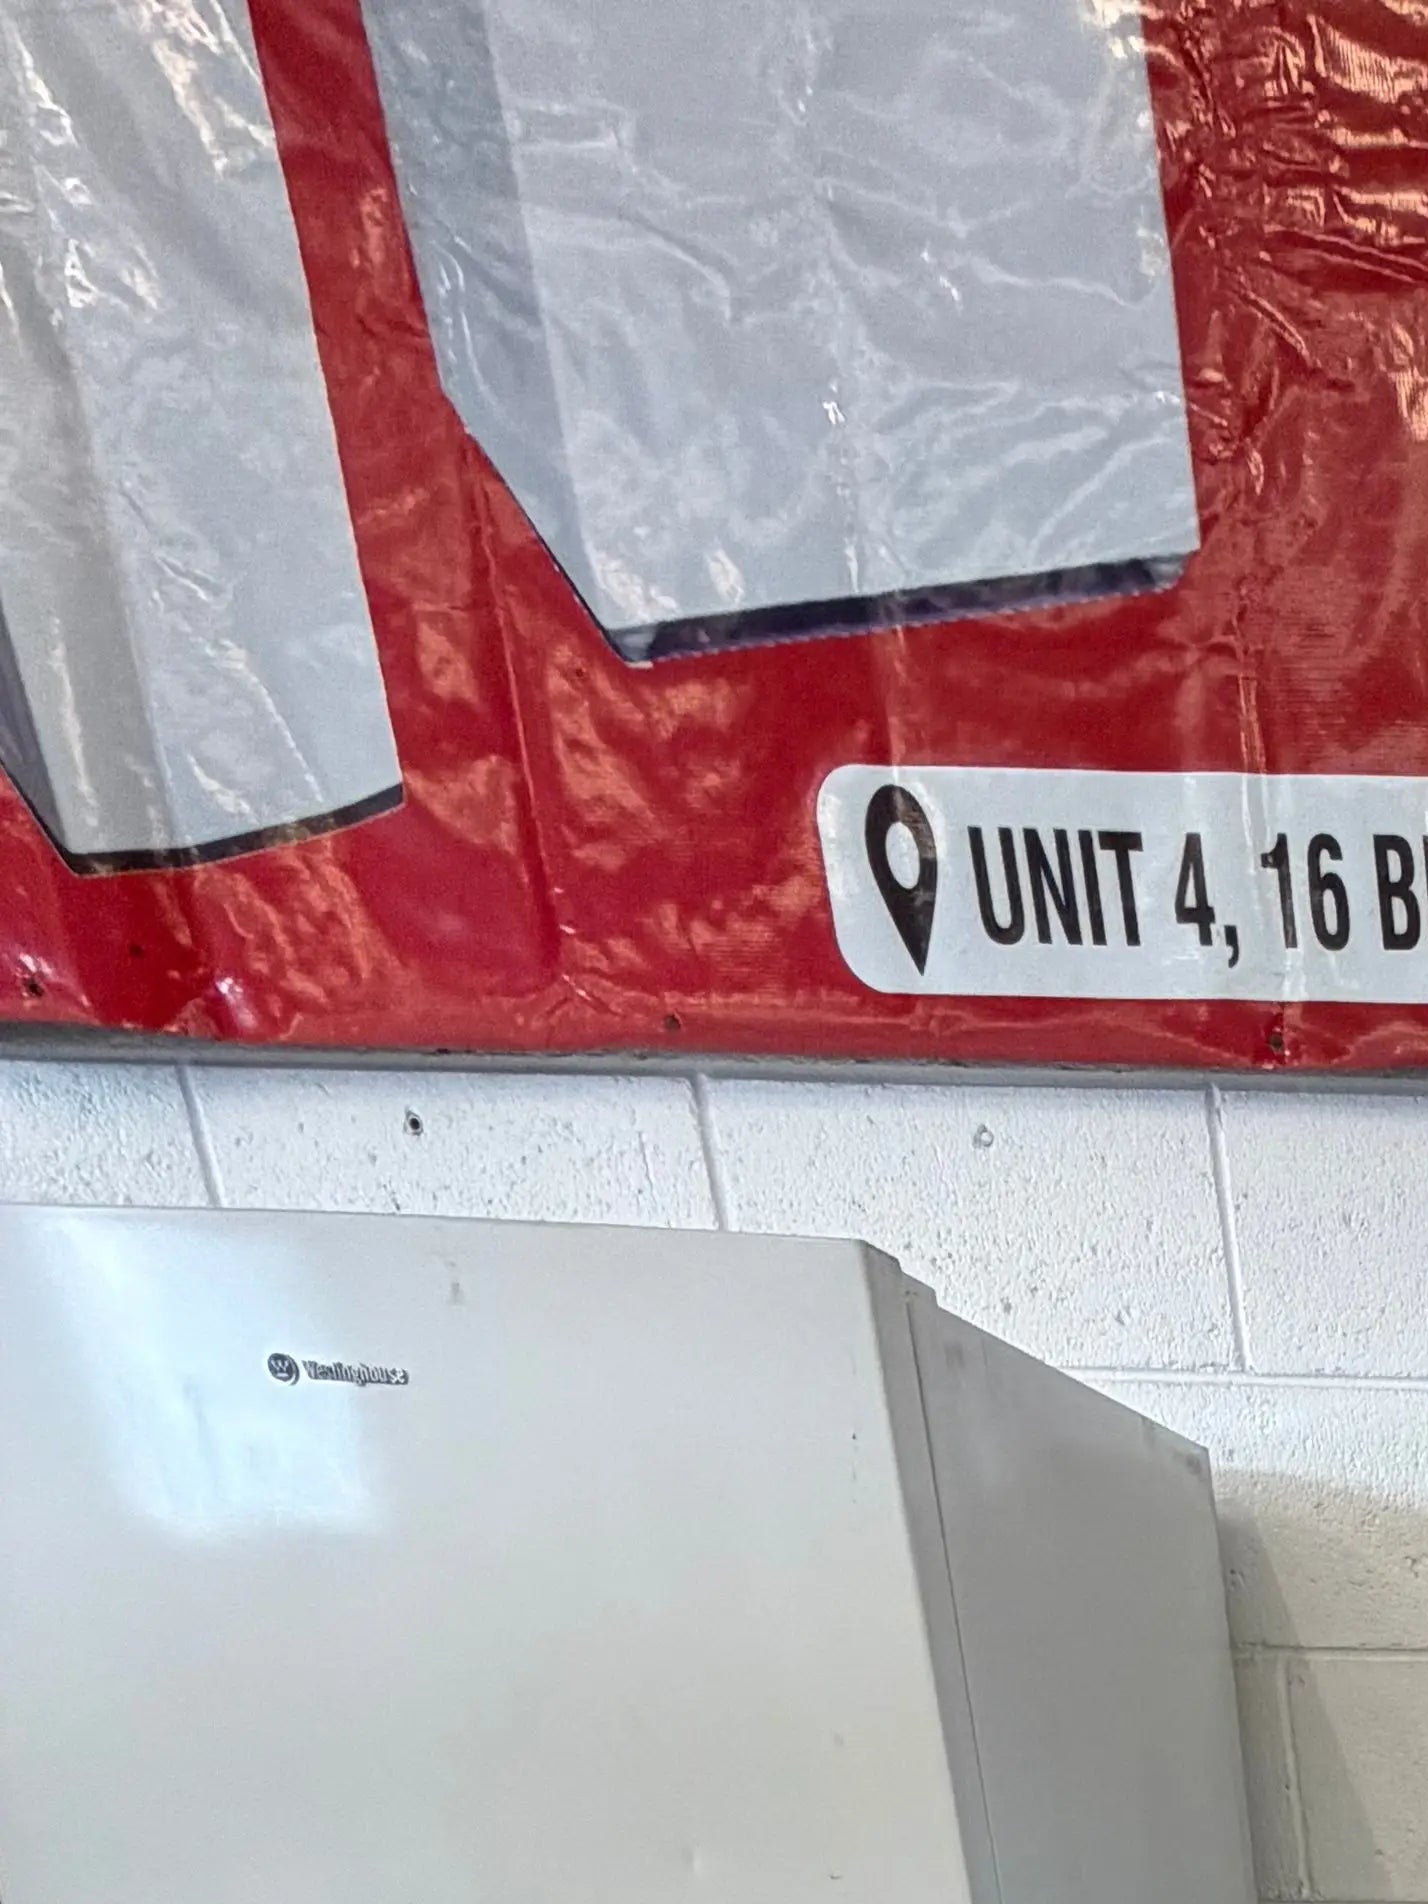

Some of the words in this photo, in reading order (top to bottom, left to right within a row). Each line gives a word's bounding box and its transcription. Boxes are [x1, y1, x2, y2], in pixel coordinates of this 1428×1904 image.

[968, 826, 1143, 948] UNIT
[1173, 832, 1240, 969] 4,
[1260, 832, 1350, 951] 16
